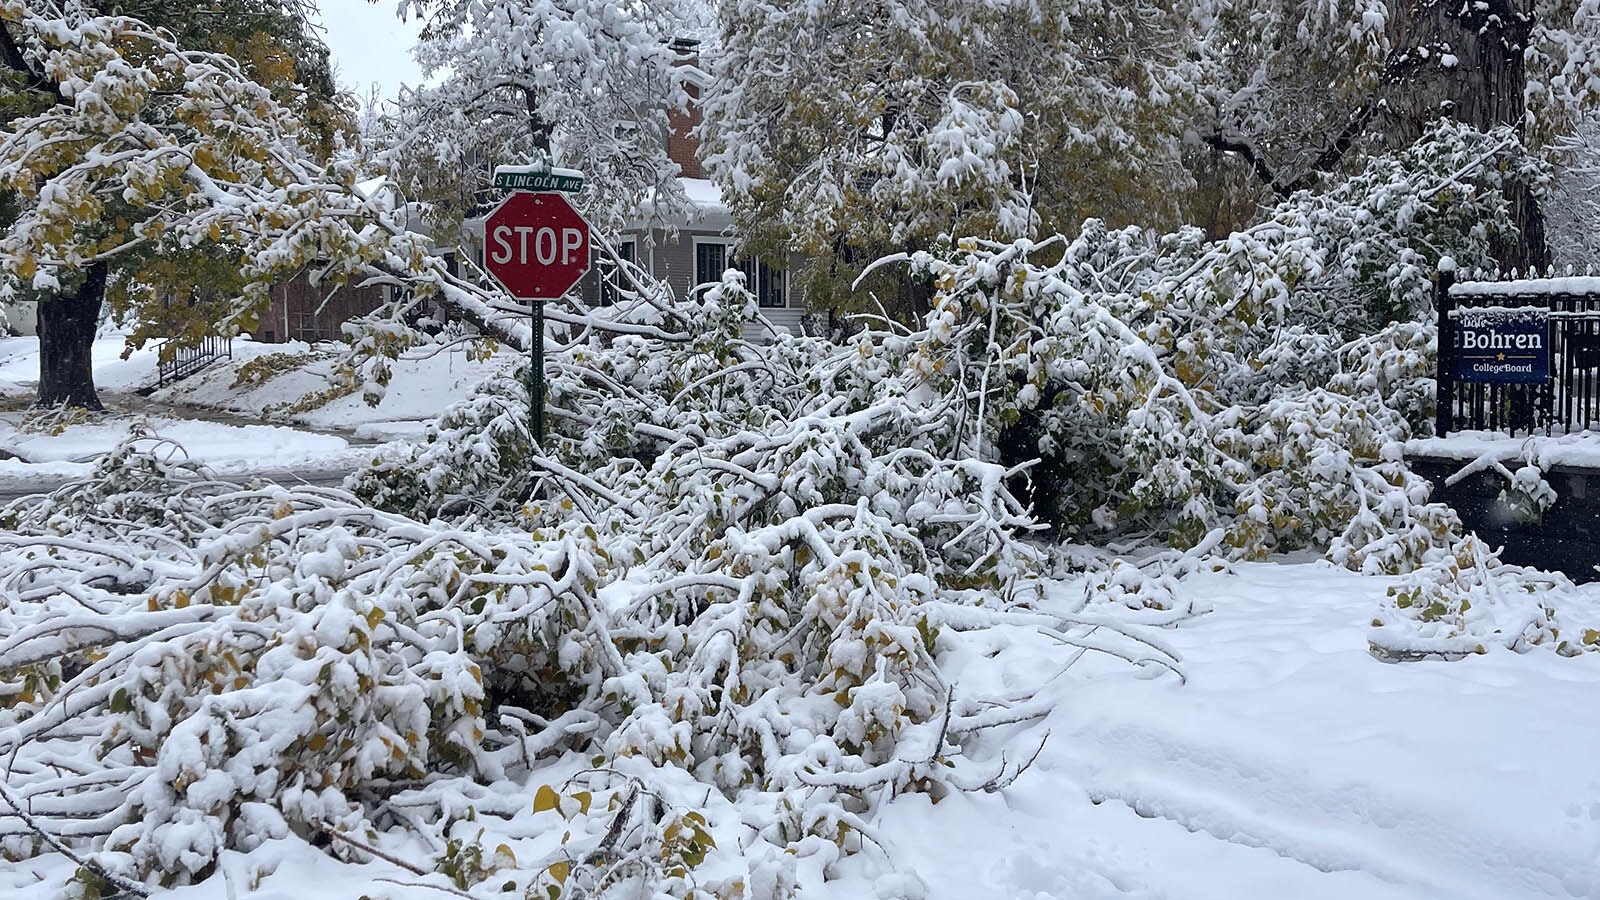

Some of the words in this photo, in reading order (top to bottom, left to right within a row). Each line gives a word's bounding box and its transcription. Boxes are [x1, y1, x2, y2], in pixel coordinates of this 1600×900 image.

[497, 176, 503, 186] S
[505, 175, 559, 189] LINCOLN
[563, 180, 582, 190] AVE
[491, 225, 583, 265] STOP
[1463, 329, 1542, 349] Bohren
[1473, 363, 1503, 374] College
[1505, 363, 1532, 373] Board
